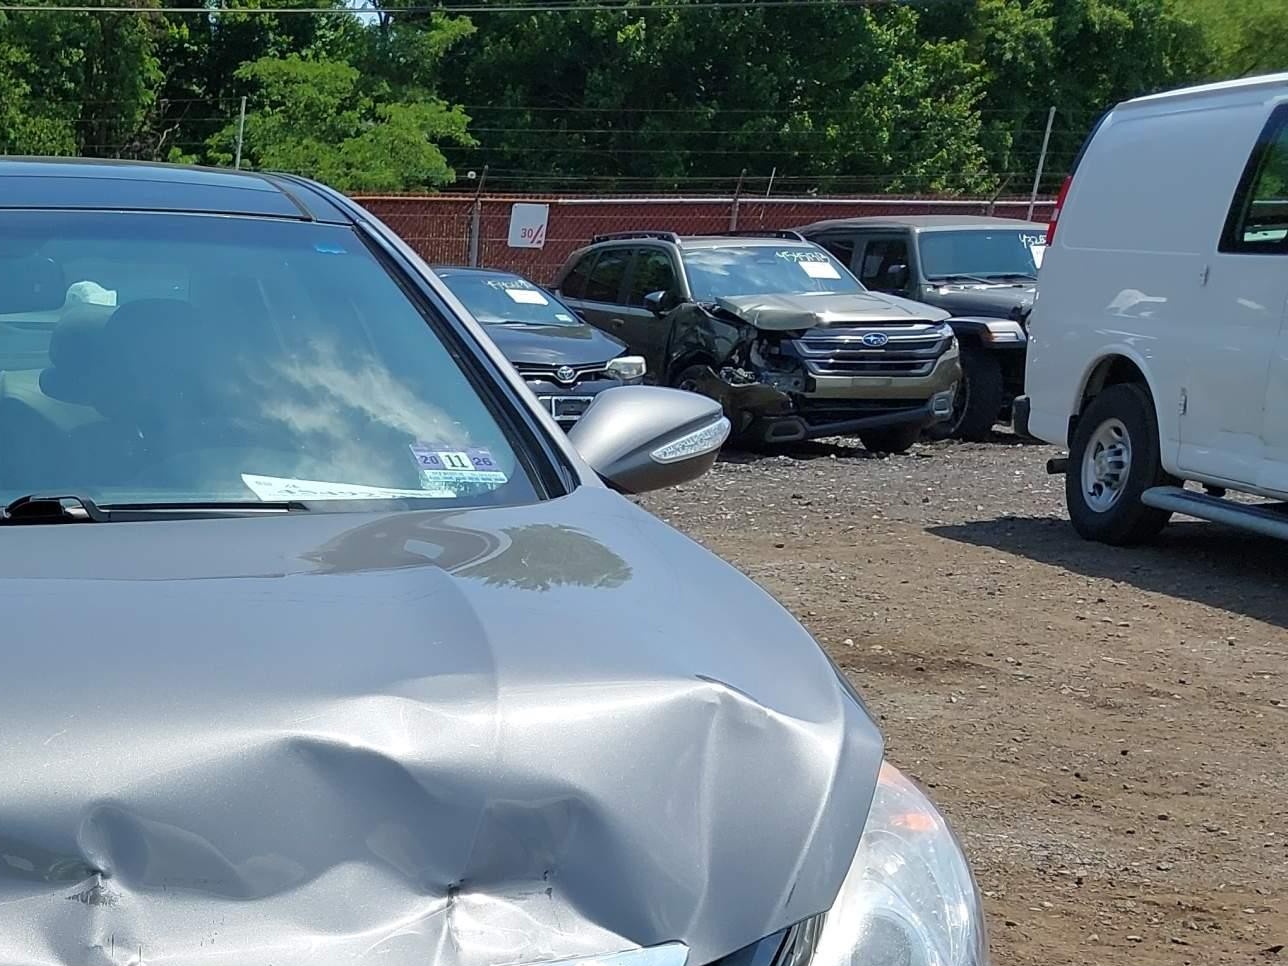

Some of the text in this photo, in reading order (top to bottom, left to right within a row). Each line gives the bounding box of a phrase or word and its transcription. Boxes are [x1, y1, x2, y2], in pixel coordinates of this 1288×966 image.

[420, 454, 492, 468] 20 11 26
